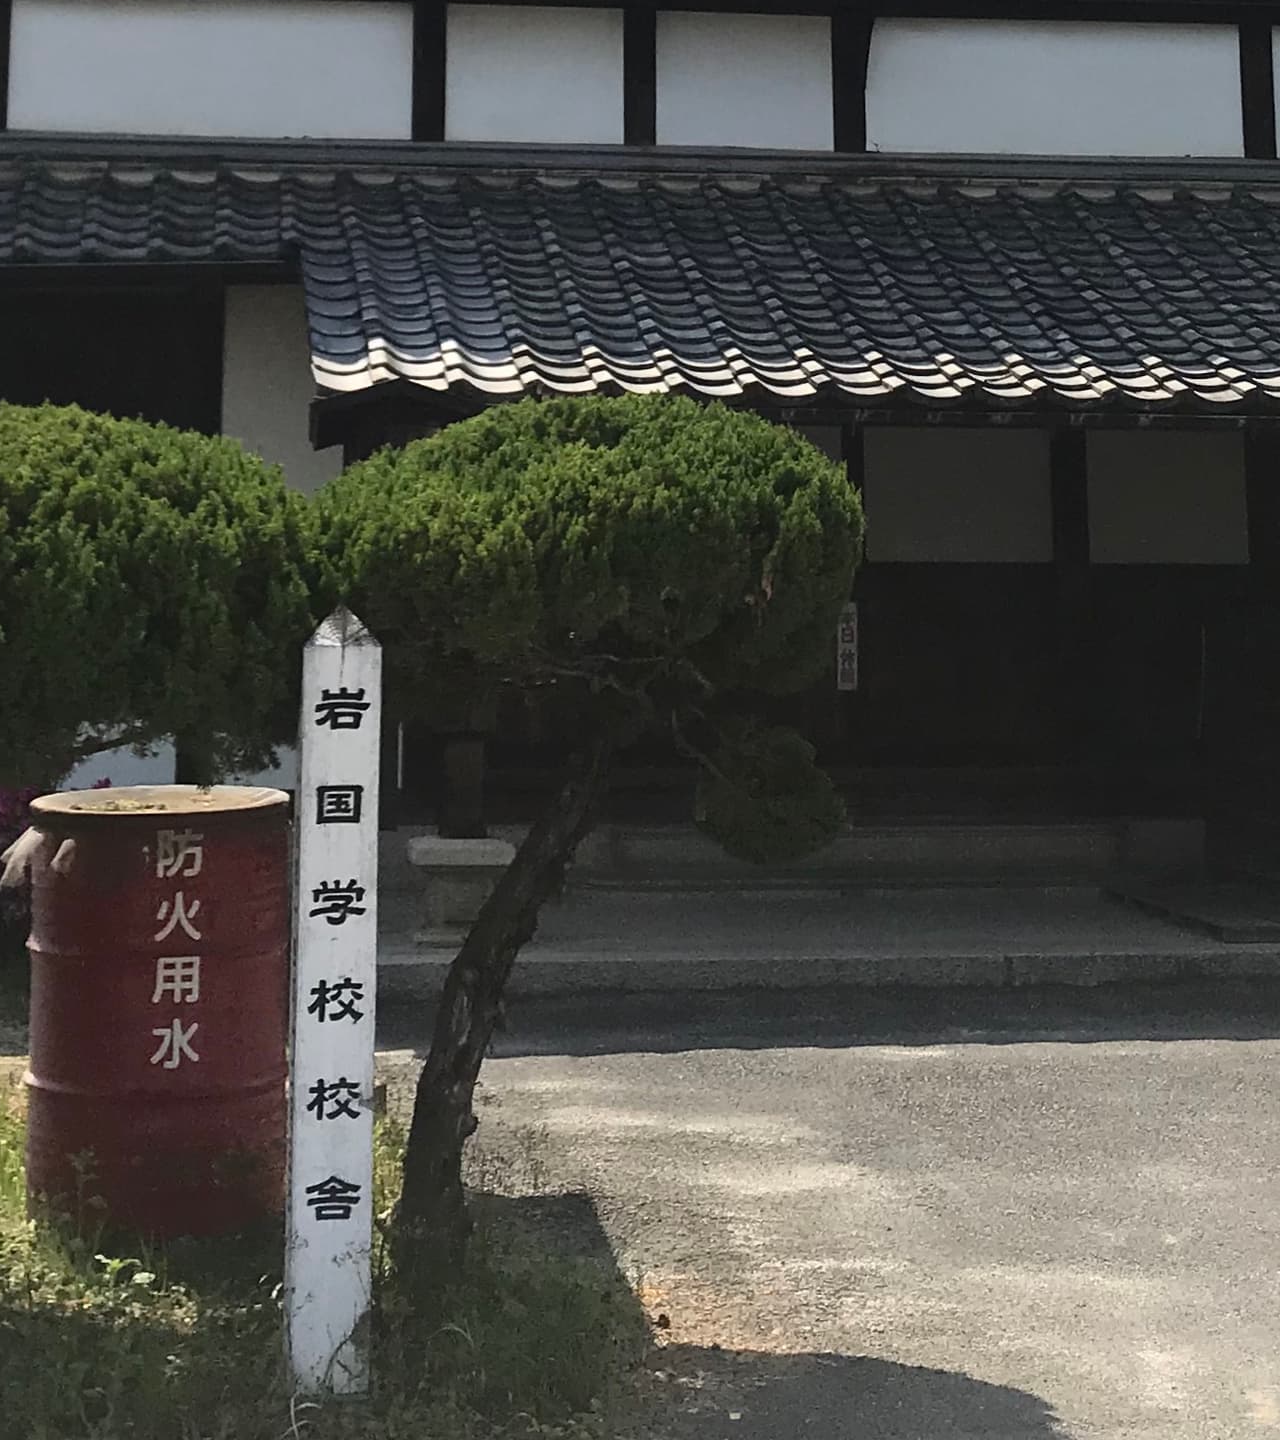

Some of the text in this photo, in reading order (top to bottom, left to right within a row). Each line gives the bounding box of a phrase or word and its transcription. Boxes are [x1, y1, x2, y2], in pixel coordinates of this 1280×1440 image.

[150, 829, 204, 1069] 防火用水
[305, 687, 371, 1222] 岩国学校校舎
